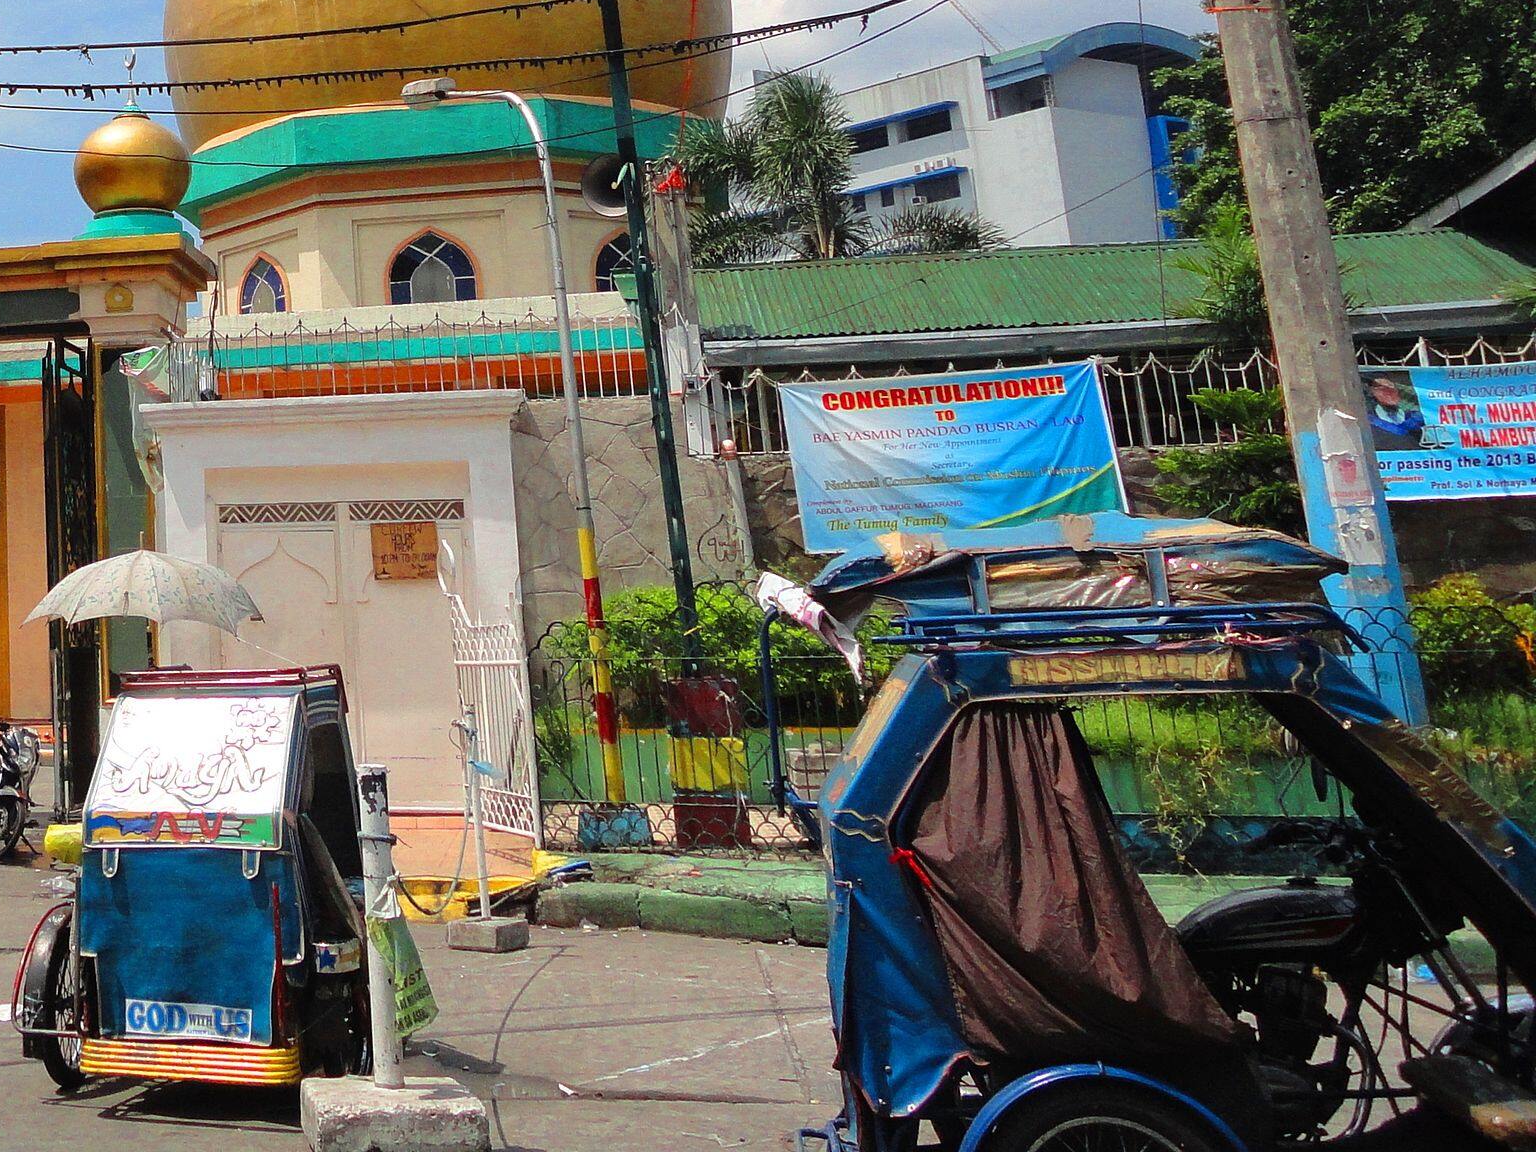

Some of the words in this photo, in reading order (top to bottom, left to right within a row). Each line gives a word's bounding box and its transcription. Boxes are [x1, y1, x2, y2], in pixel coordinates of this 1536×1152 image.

[822, 375, 1066, 412] CONGRATULATION!!!
[1428, 390, 1453, 399] and
[934, 409, 956, 422] TO
[1438, 404, 1484, 425] ATTY.
[813, 431, 841, 444] BAE
[845, 428, 902, 443] YASMIN
[906, 424, 971, 438] PANDAO
[975, 418, 1039, 434] BUSRAN
[1052, 414, 1085, 428] LAO
[883, 443, 899, 451] For
[900, 442, 918, 450] Her
[944, 438, 1001, 451] Appointment
[1378, 460, 1393, 470] or
[1397, 458, 1452, 472] passing
[1458, 456, 1481, 467] the
[1486, 453, 1522, 467] 2013
[825, 477, 880, 491] National
[883, 474, 963, 489] Commission
[985, 467, 1036, 481] Muslim
[1040, 465, 1096, 478] Filipinos
[1381, 475, 1424, 483] mpliments:
[1431, 481, 1454, 489] Prof.
[1456, 480, 1472, 489] Sol
[1476, 480, 1483, 488] &
[816, 507, 844, 515] ABDUL
[845, 506, 880, 514] GAFFUR
[827, 518, 851, 531] The
[853, 517, 899, 532] Tumug
[904, 512, 949, 529] Family
[127, 1001, 188, 1032] GOD
[189, 1014, 213, 1027] WITH
[214, 1006, 250, 1038] US
